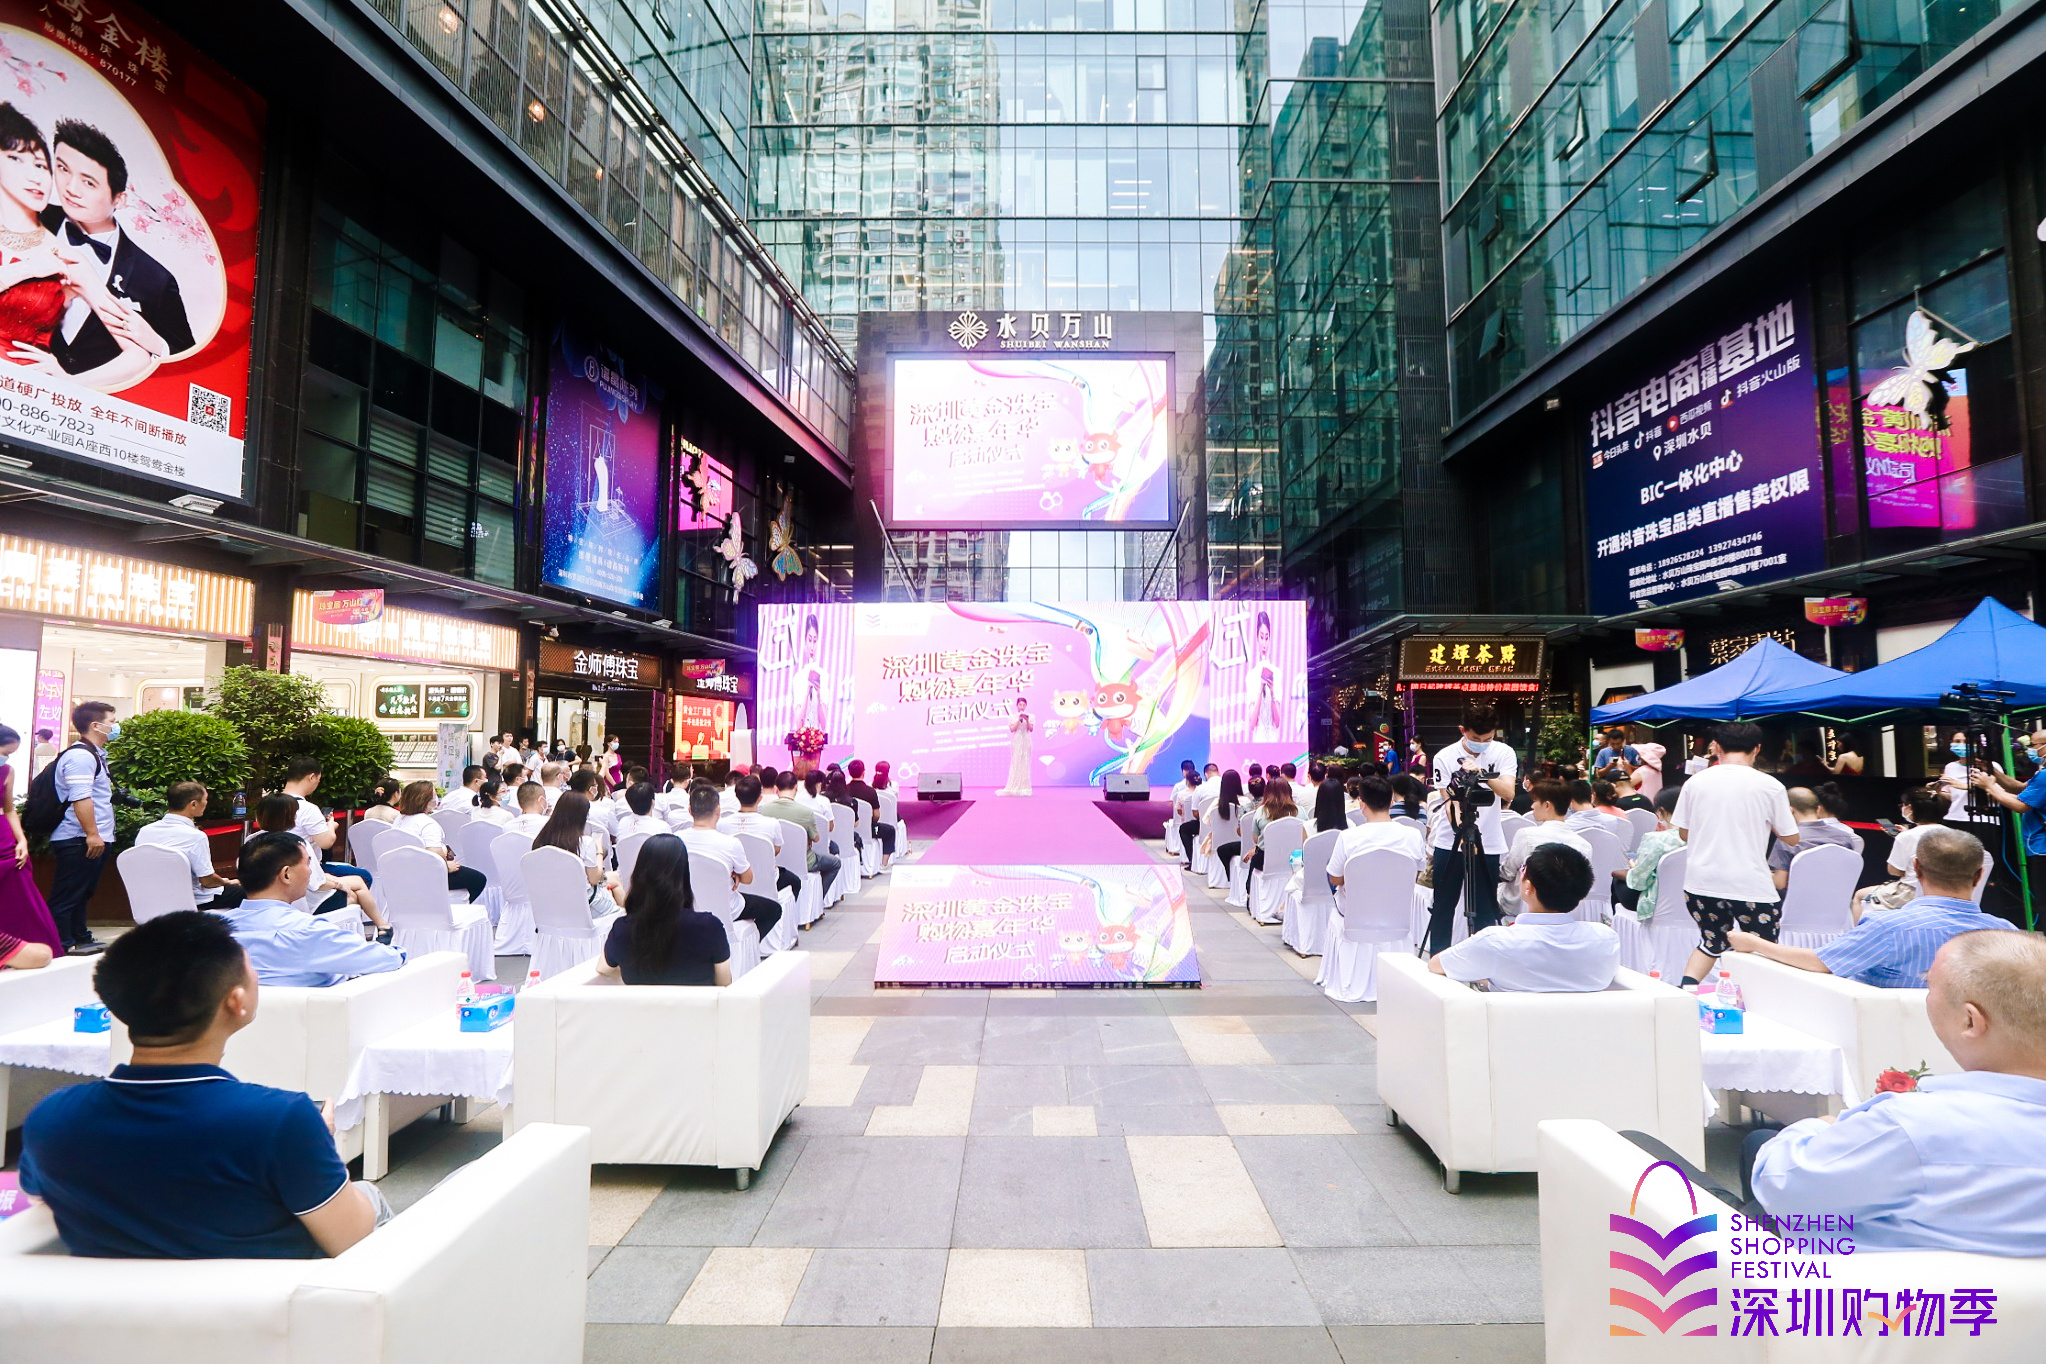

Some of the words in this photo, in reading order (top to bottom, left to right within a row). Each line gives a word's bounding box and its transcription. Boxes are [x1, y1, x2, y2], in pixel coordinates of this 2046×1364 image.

[996, 312, 1112, 340] 水贝万山
[1000, 339, 1047, 350] SHUIBEI
[1053, 339, 1110, 350] WANSHAN
[1645, 424, 1663, 443] 抖音
[1679, 400, 1713, 426] 西瓜视频
[1736, 353, 1801, 399] 抖音火山版
[0, 397, 95, 436] 0-886-7823
[90, 405, 188, 447] 全年不间断播放
[1664, 420, 1713, 456] 深圳水贝
[1640, 449, 1744, 505] BIC一体化中心
[1596, 467, 1811, 559] 开通抖音珠宝品类直播售卖权限
[882, 642, 1052, 681] 深圳黄金珠宝
[899, 668, 1035, 703] 购物嘉年华
[926, 698, 1013, 727] 启动仪式
[1434, 768, 1442, 783] 3
[901, 893, 1074, 923] 深圳黄金珠宝
[915, 914, 1056, 944] 购物嘉年华
[943, 940, 1036, 965] 启动仪式
